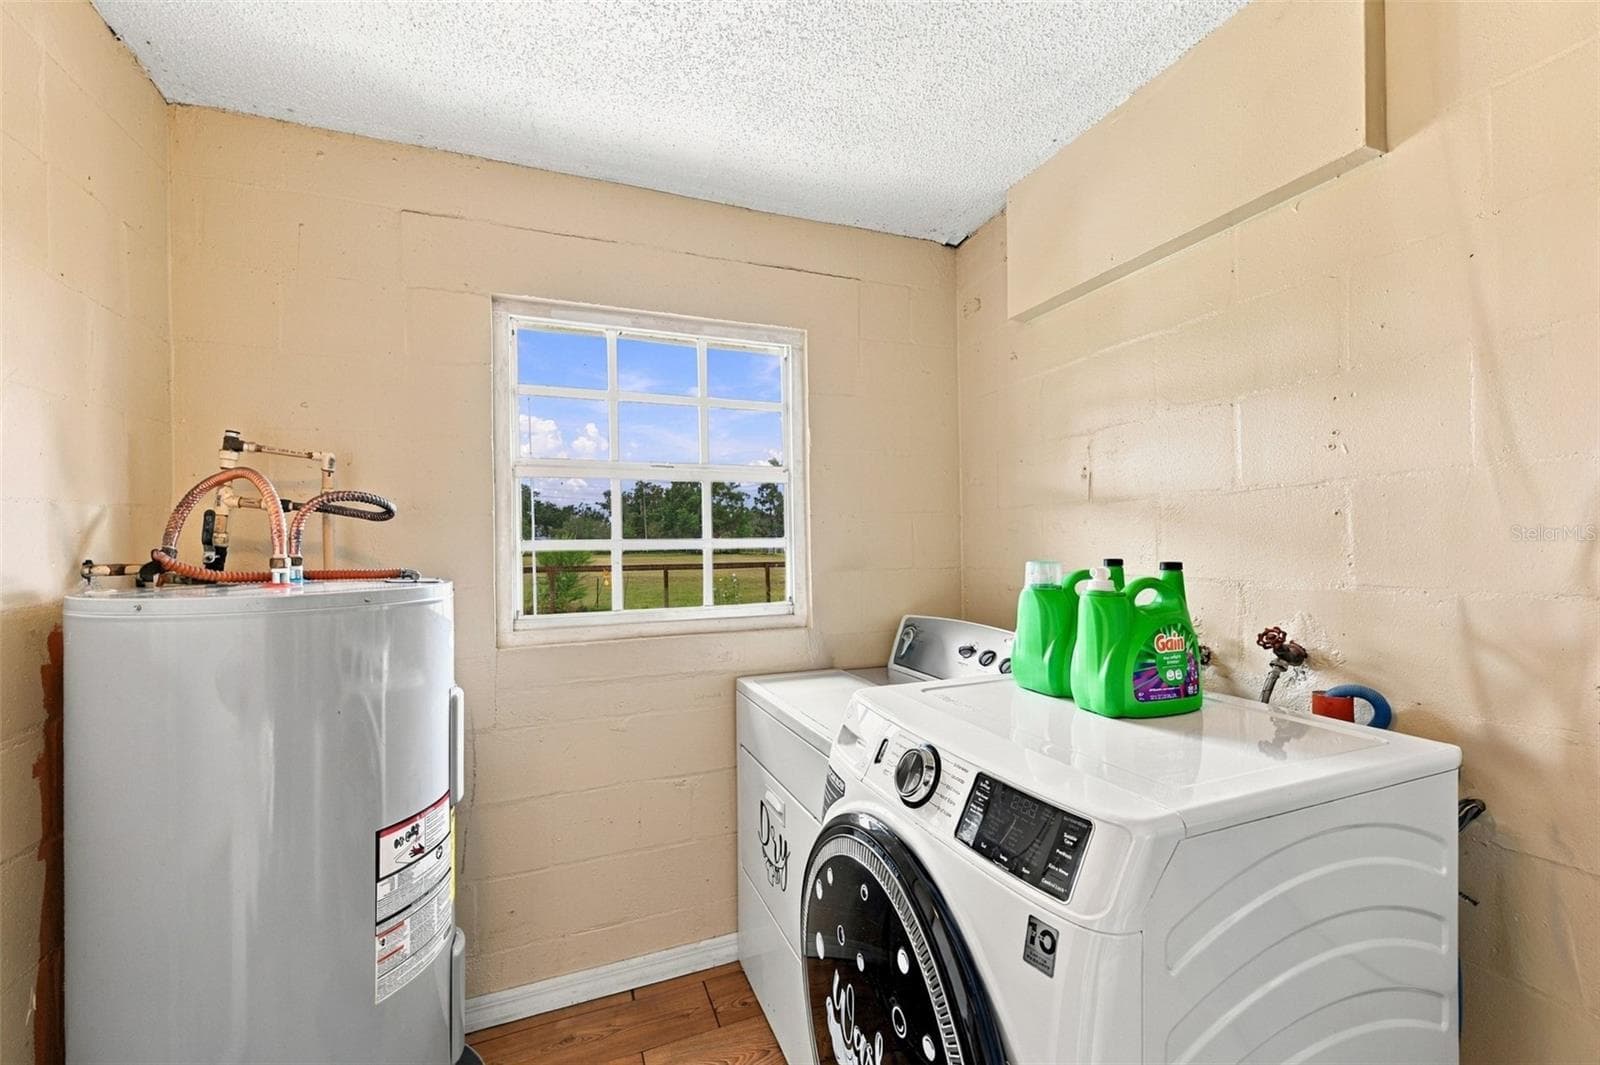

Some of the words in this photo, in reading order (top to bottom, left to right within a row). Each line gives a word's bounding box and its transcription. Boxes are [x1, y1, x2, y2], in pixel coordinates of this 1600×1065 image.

[1155, 631, 1185, 653] Gain
[758, 800, 791, 892] Dry
[1029, 921, 1057, 955] 10
